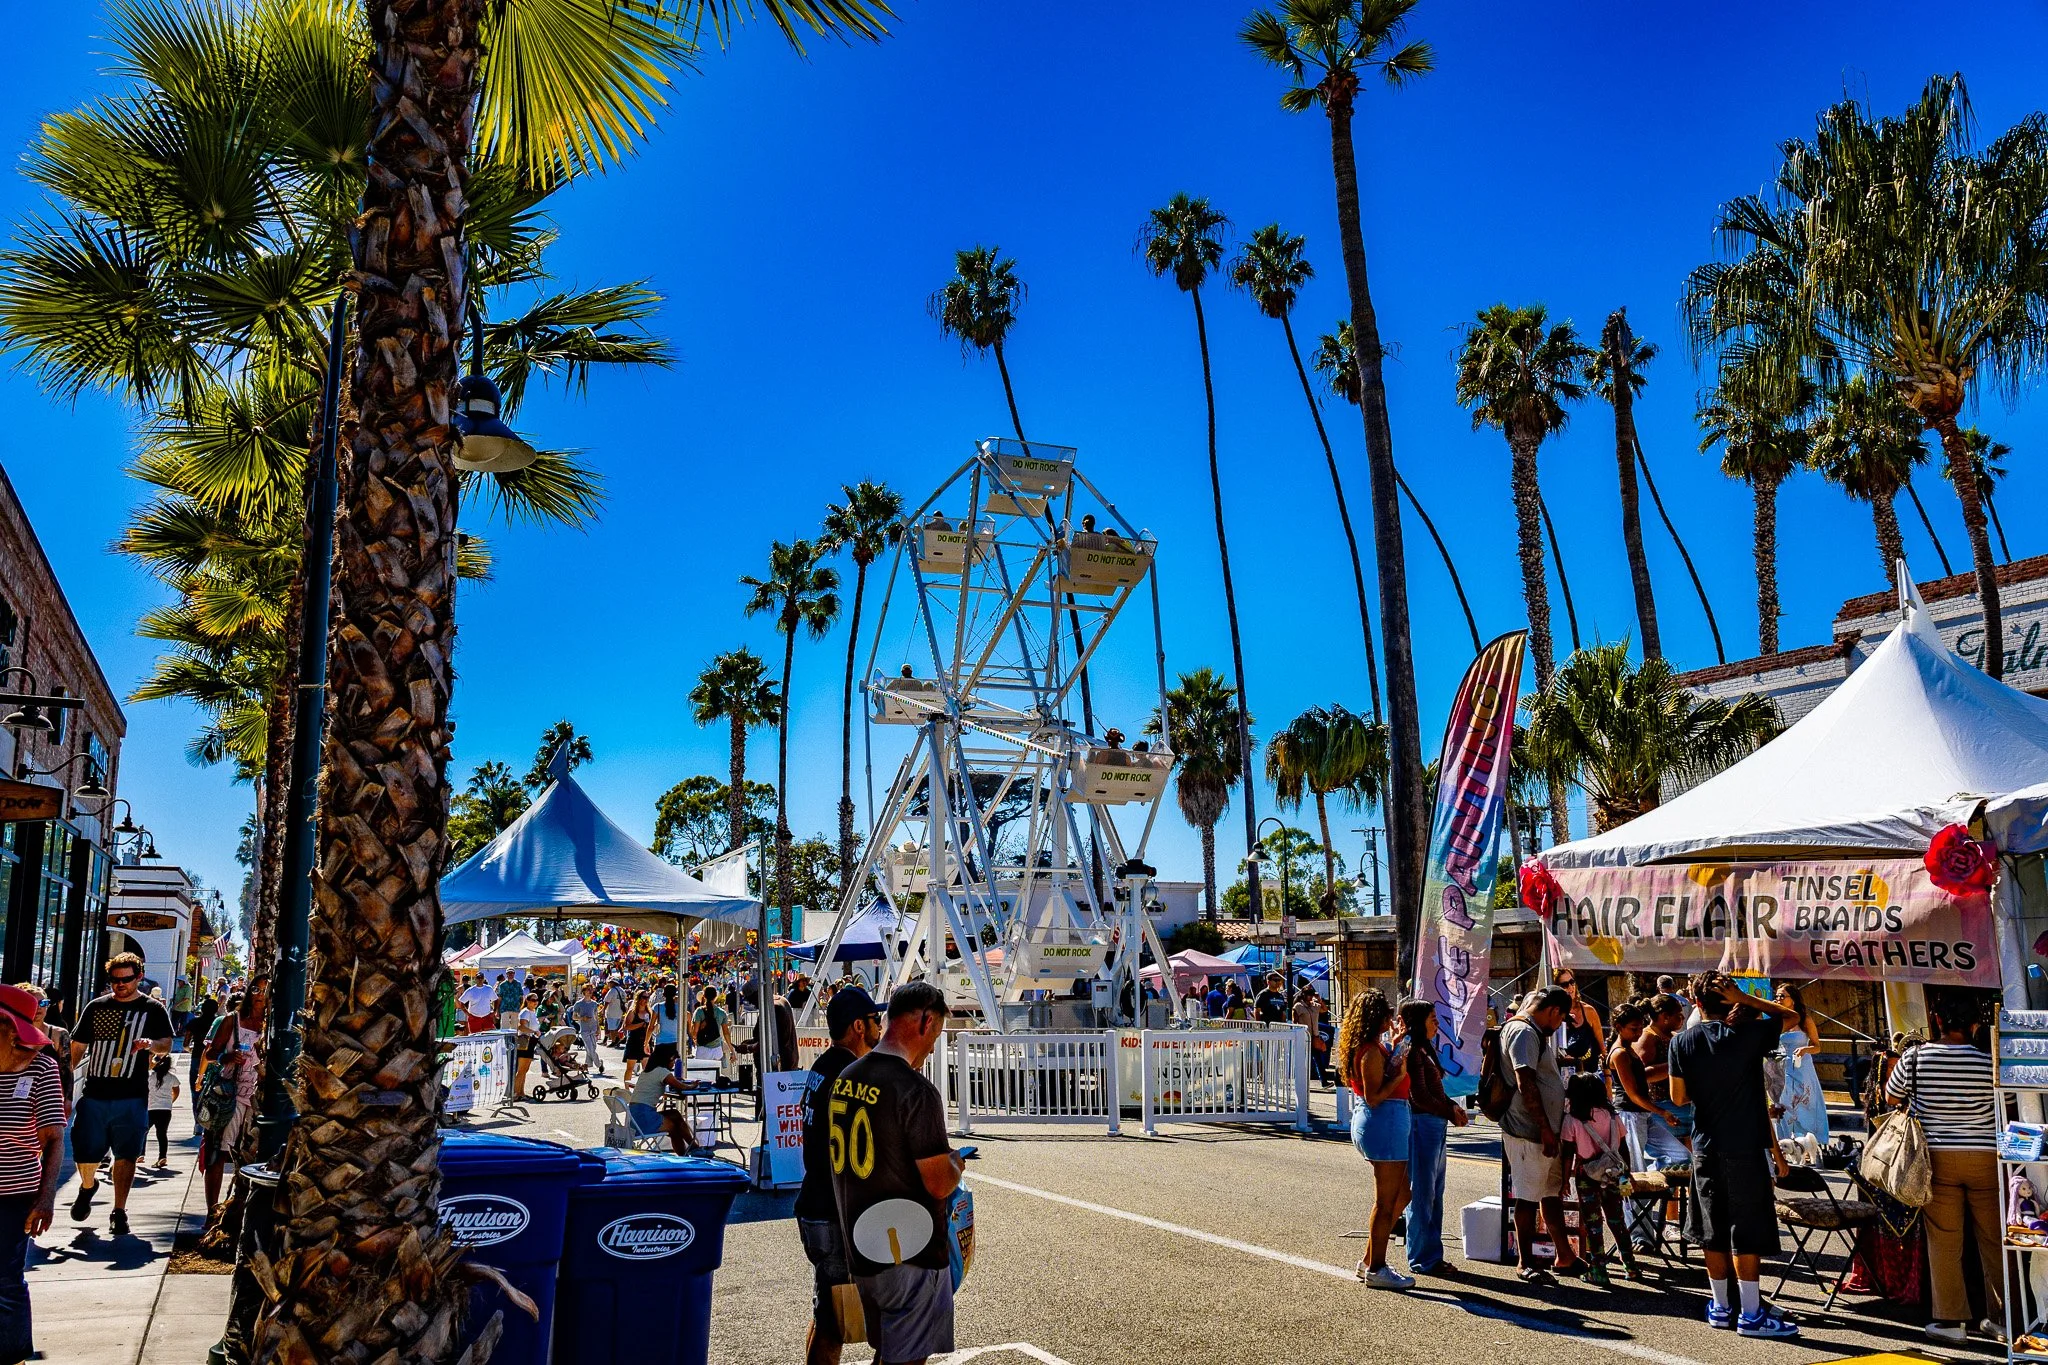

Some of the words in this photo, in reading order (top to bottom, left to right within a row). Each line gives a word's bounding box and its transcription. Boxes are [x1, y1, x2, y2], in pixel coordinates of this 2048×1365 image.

[1012, 459, 1023, 469] DO
[1024, 461, 1039, 470] NOT
[1040, 462, 1058, 473] ROCK
[937, 534, 947, 542] DO
[948, 535, 961, 543] NOT
[1087, 553, 1099, 562] DO
[1100, 554, 1115, 564] NOT
[1116, 556, 1137, 567] ROCK
[1101, 771, 1112, 781] DO
[1114, 772, 1130, 782] NOT
[1131, 773, 1152, 782] ROCK
[1441, 683, 1500, 931] PAINTING
[904, 868, 914, 876] DO
[915, 868, 928, 876] NOT
[1781, 875, 1878, 902] TINSEL
[1551, 893, 1641, 938] HAIR
[1653, 893, 1780, 940] FLAIR
[1795, 905, 1904, 934] BRAIDS
[1043, 947, 1055, 957] DO
[1056, 948, 1070, 957] NOT
[1072, 948, 1092, 957] ROCK
[1809, 939, 1977, 971] FEATHERS
[1434, 935, 1470, 1077] FACE
[798, 1037, 823, 1048] UNDER
[824, 1038, 830, 1048] 5
[832, 1078, 881, 1105] RAMS
[829, 1099, 875, 1179] 50
[437, 1206, 523, 1229] Harrison
[607, 1224, 689, 1246] Harrison
[631, 1244, 671, 1254] Industries
